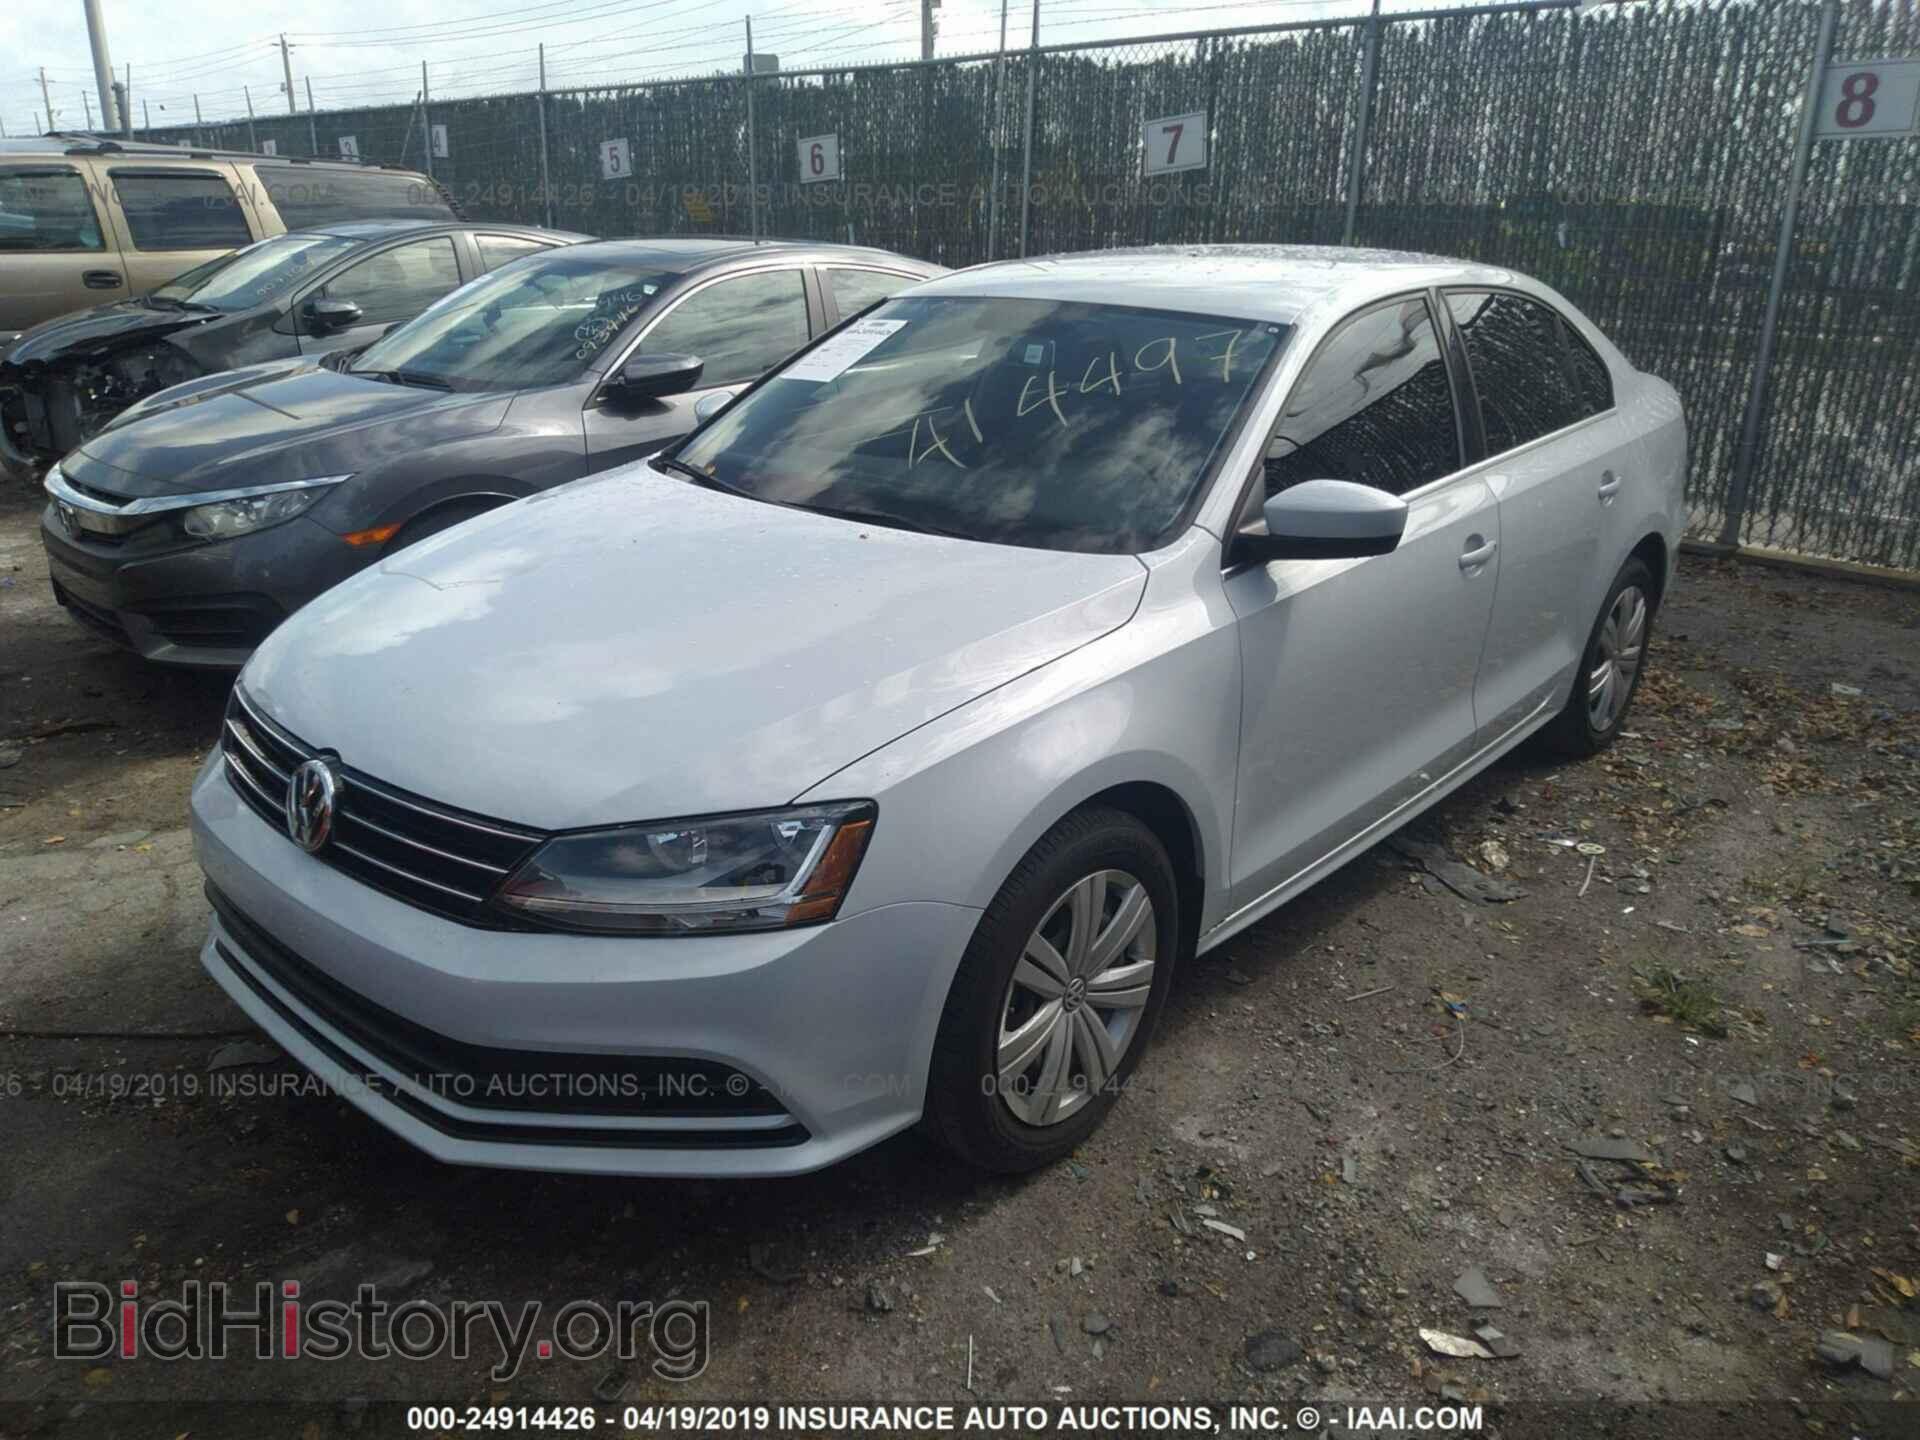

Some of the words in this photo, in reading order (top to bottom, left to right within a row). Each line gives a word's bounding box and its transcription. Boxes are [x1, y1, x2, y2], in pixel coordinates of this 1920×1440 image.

[1835, 72, 1879, 128] 8
[608, 146, 620, 173] 5
[811, 143, 825, 175] 6
[1162, 124, 1184, 164] 7
